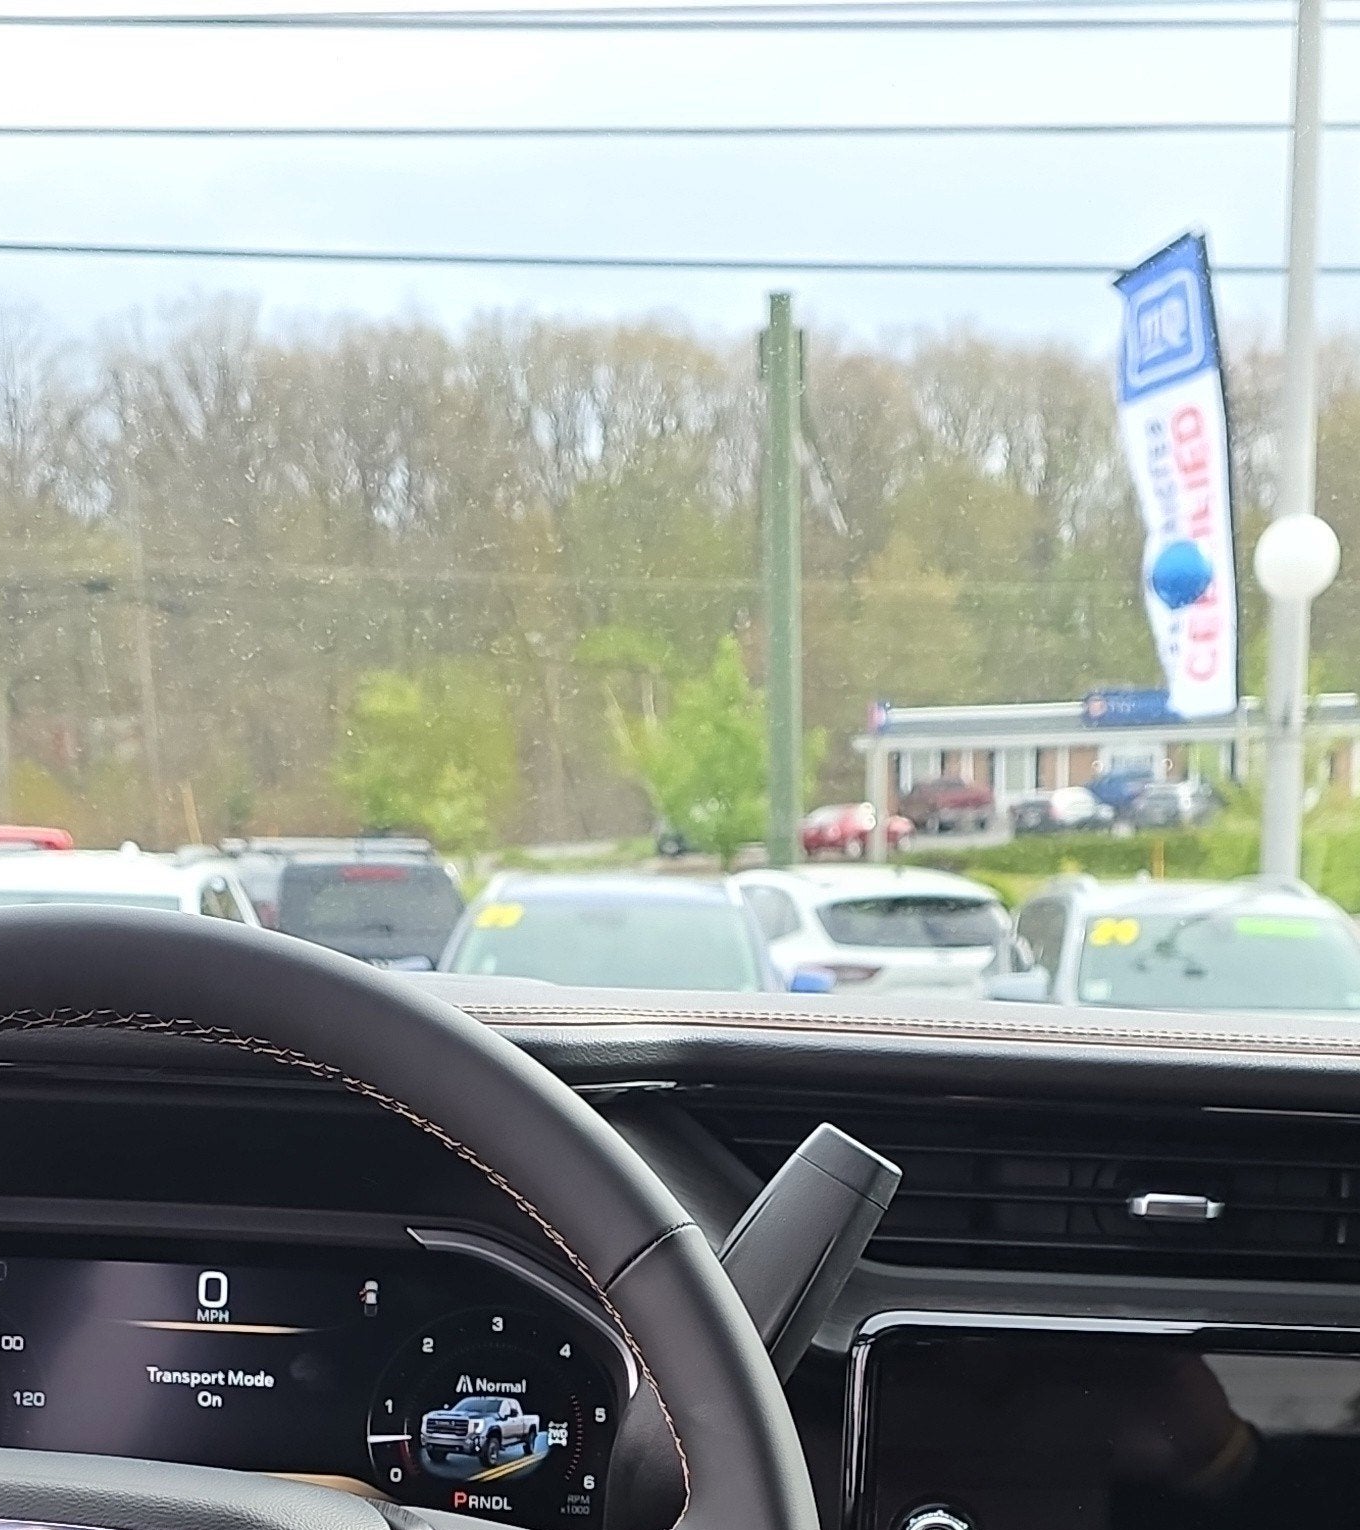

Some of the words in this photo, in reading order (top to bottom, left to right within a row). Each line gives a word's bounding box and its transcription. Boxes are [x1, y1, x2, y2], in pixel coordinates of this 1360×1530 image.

[197, 1270, 229, 1309] 0
[196, 1309, 230, 1323] MPH
[492, 1316, 504, 1332] 3
[421, 1337, 434, 1353] 2
[559, 1343, 572, 1359] 4
[146, 1366, 226, 1388] Transport
[227, 1370, 275, 1388] Mode
[475, 1378, 527, 1394] Normal
[13, 1391, 46, 1408] 120
[197, 1390, 223, 1408] On
[384, 1399, 393, 1414] 1
[594, 1406, 607, 1423] 5
[390, 1467, 403, 1483] 0
[583, 1474, 595, 1490] 6
[566, 1494, 591, 1505] RPM
